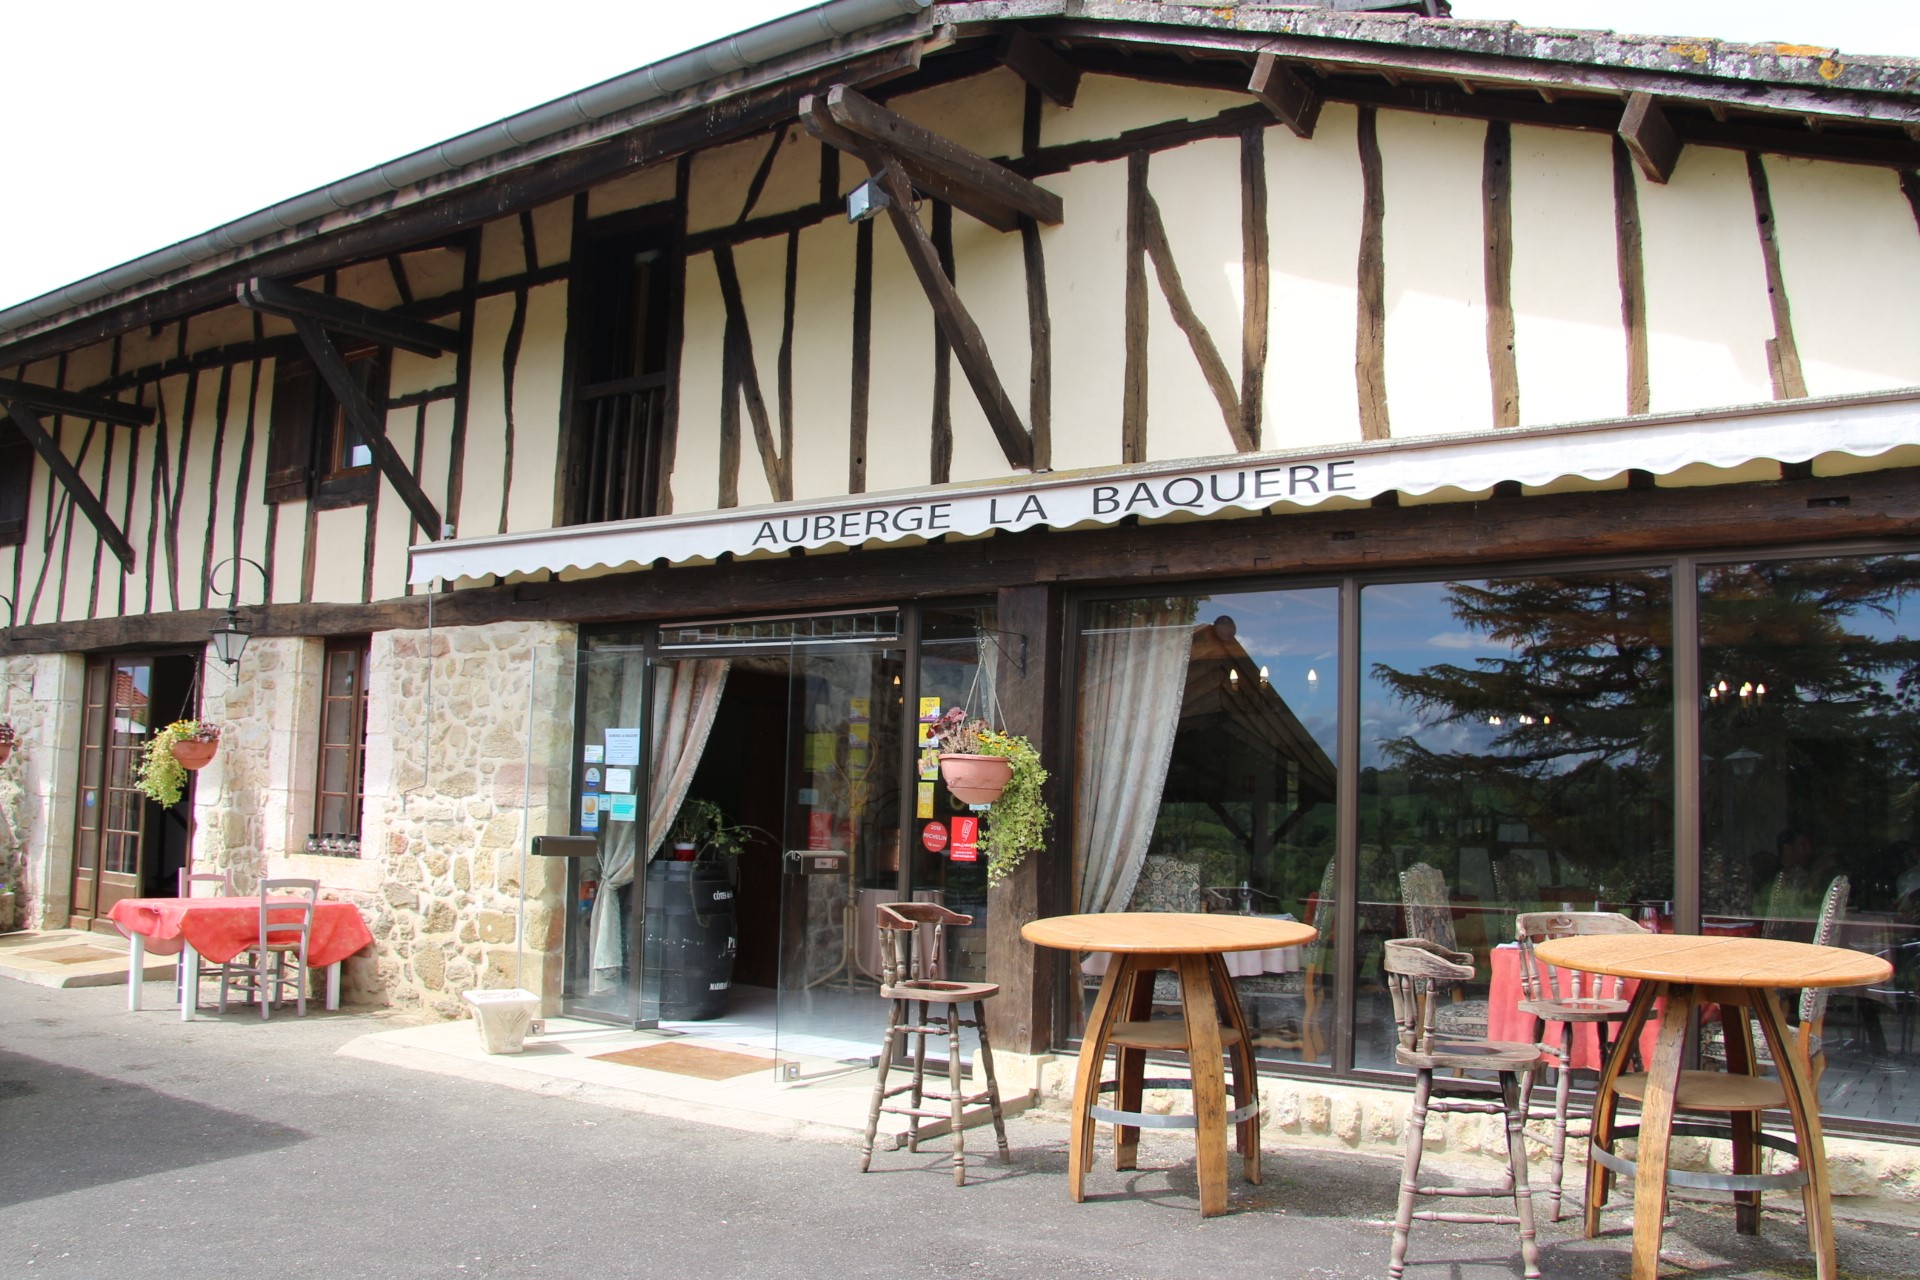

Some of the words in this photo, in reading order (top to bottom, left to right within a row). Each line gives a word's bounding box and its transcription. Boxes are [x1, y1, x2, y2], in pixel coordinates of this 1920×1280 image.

[752, 503, 952, 546] AUBERGE
[989, 494, 1048, 525] LA
[1093, 460, 1356, 515] BAQUERE
[923, 832, 947, 842] MICHELIN
